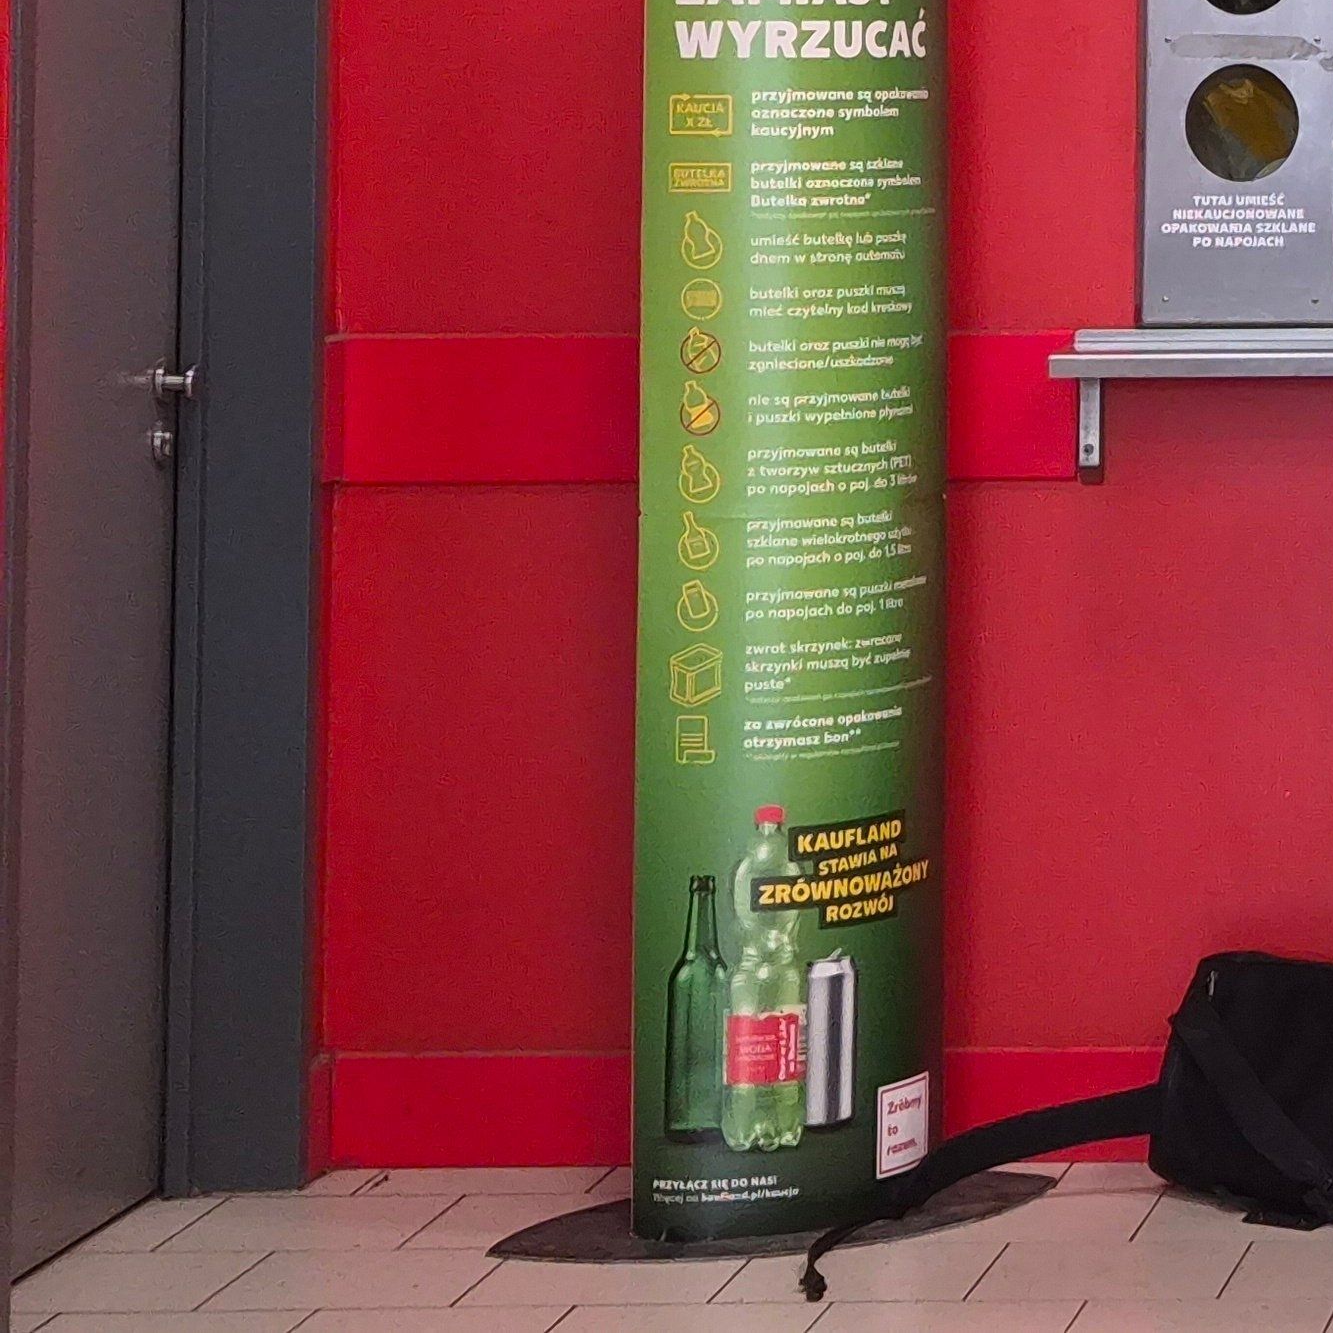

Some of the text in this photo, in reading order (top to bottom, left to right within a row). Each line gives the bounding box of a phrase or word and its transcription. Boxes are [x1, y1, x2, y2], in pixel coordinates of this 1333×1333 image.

[676, 8, 926, 59] WYRZUCAĆ
[752, 90, 871, 104] przyjmowane są
[751, 108, 834, 118] oznaczone
[751, 124, 834, 139] kaucyjnym
[751, 160, 862, 174] przyjmowane są
[751, 177, 801, 188] butelki
[1193, 193, 1285, 206] TUTAJ UMIEŚĆ
[1173, 209, 1304, 219] NIEKAUCJONOWANE
[1161, 223, 1316, 233] OPAKOWANIA SZKLANE
[751, 234, 800, 246] umieść
[1193, 236, 1284, 247] PO NAPOJACH
[751, 252, 806, 263] dnem w
[750, 287, 798, 299] butelki
[804, 288, 833, 298] oraz
[748, 446, 841, 462] przyjmowane
[798, 819, 901, 854] KAUFLAND
[819, 845, 898, 875] STAWIA NA
[758, 860, 930, 906] ZRÓWNOWAŻONY
[827, 896, 894, 923] ROZWÓJ
[731, 1178, 748, 1187] DO
